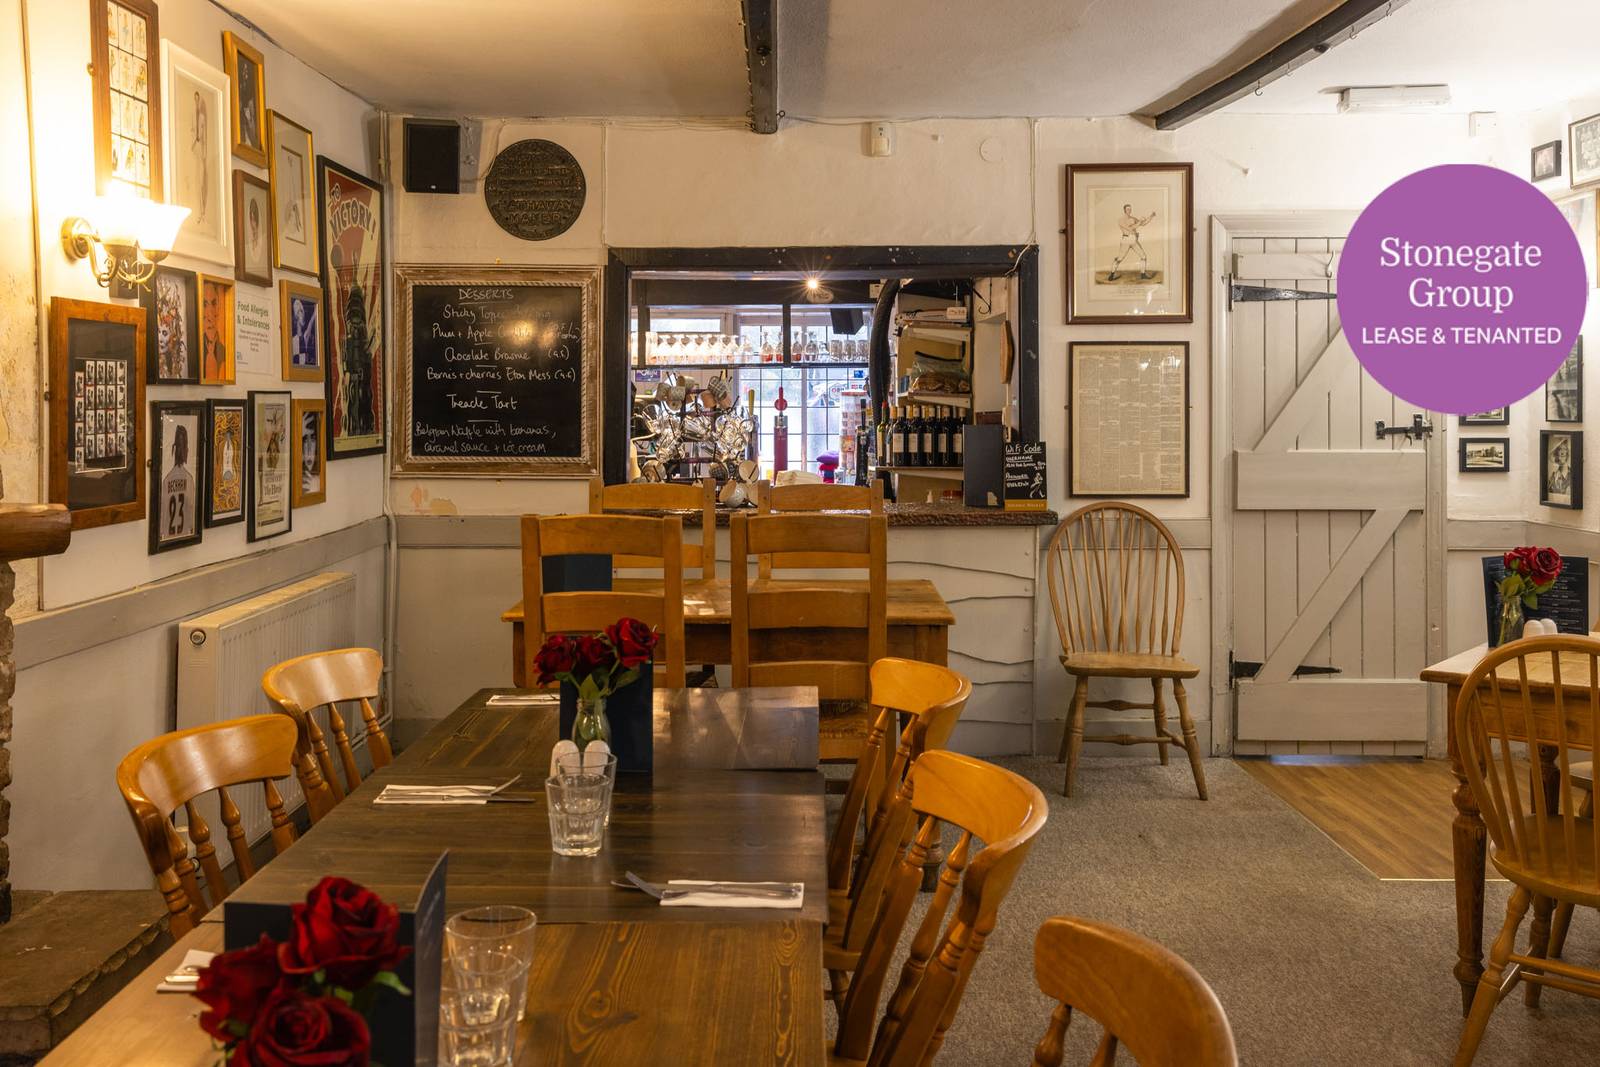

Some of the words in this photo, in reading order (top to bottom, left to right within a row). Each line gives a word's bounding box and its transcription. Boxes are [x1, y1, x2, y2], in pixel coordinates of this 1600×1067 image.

[329, 183, 342, 206] TO
[458, 288, 514, 300] DESSERTS
[237, 302, 250, 313] Food
[443, 305, 475, 322] Sticky
[432, 323, 455, 338] Plum
[467, 327, 492, 343] Apple
[445, 347, 489, 362] Chocolate
[494, 351, 530, 361] Brownie
[506, 367, 526, 381] Eton
[529, 369, 551, 381] Mess
[446, 394, 488, 409] Treacle
[491, 395, 518, 410] Tart
[485, 422, 506, 436] with
[461, 442, 488, 453] sauce
[1024, 442, 1042, 453] Code
[168, 479, 187, 494] BECKHAM
[169, 493, 185, 535] 23
